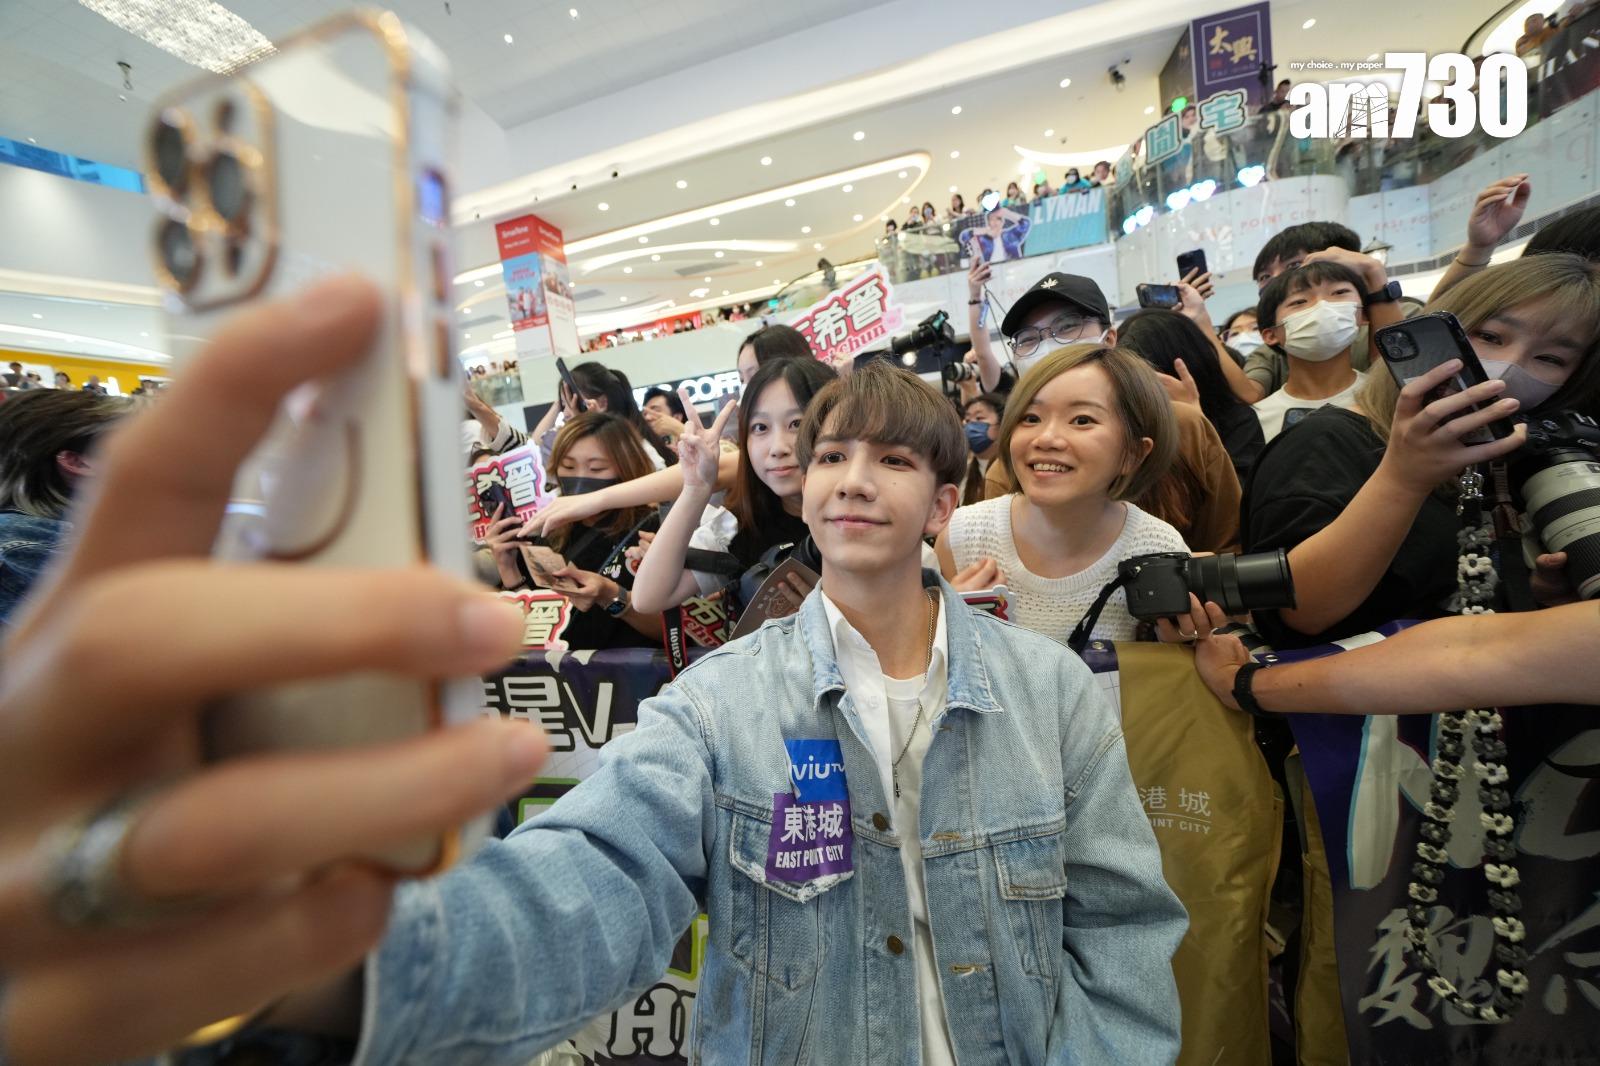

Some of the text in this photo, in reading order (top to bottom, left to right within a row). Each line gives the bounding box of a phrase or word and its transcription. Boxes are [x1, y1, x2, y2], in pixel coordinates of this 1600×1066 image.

[1209, 26, 1257, 63] 太興
[1202, 95, 1245, 131] 宅
[1033, 189, 1102, 224] LYMAN
[669, 627, 684, 669] Canon
[780, 803, 844, 844] 東港城
[1180, 820, 1211, 835] CITY
[775, 850, 802, 869] EAST
[825, 844, 844, 862] CITY
